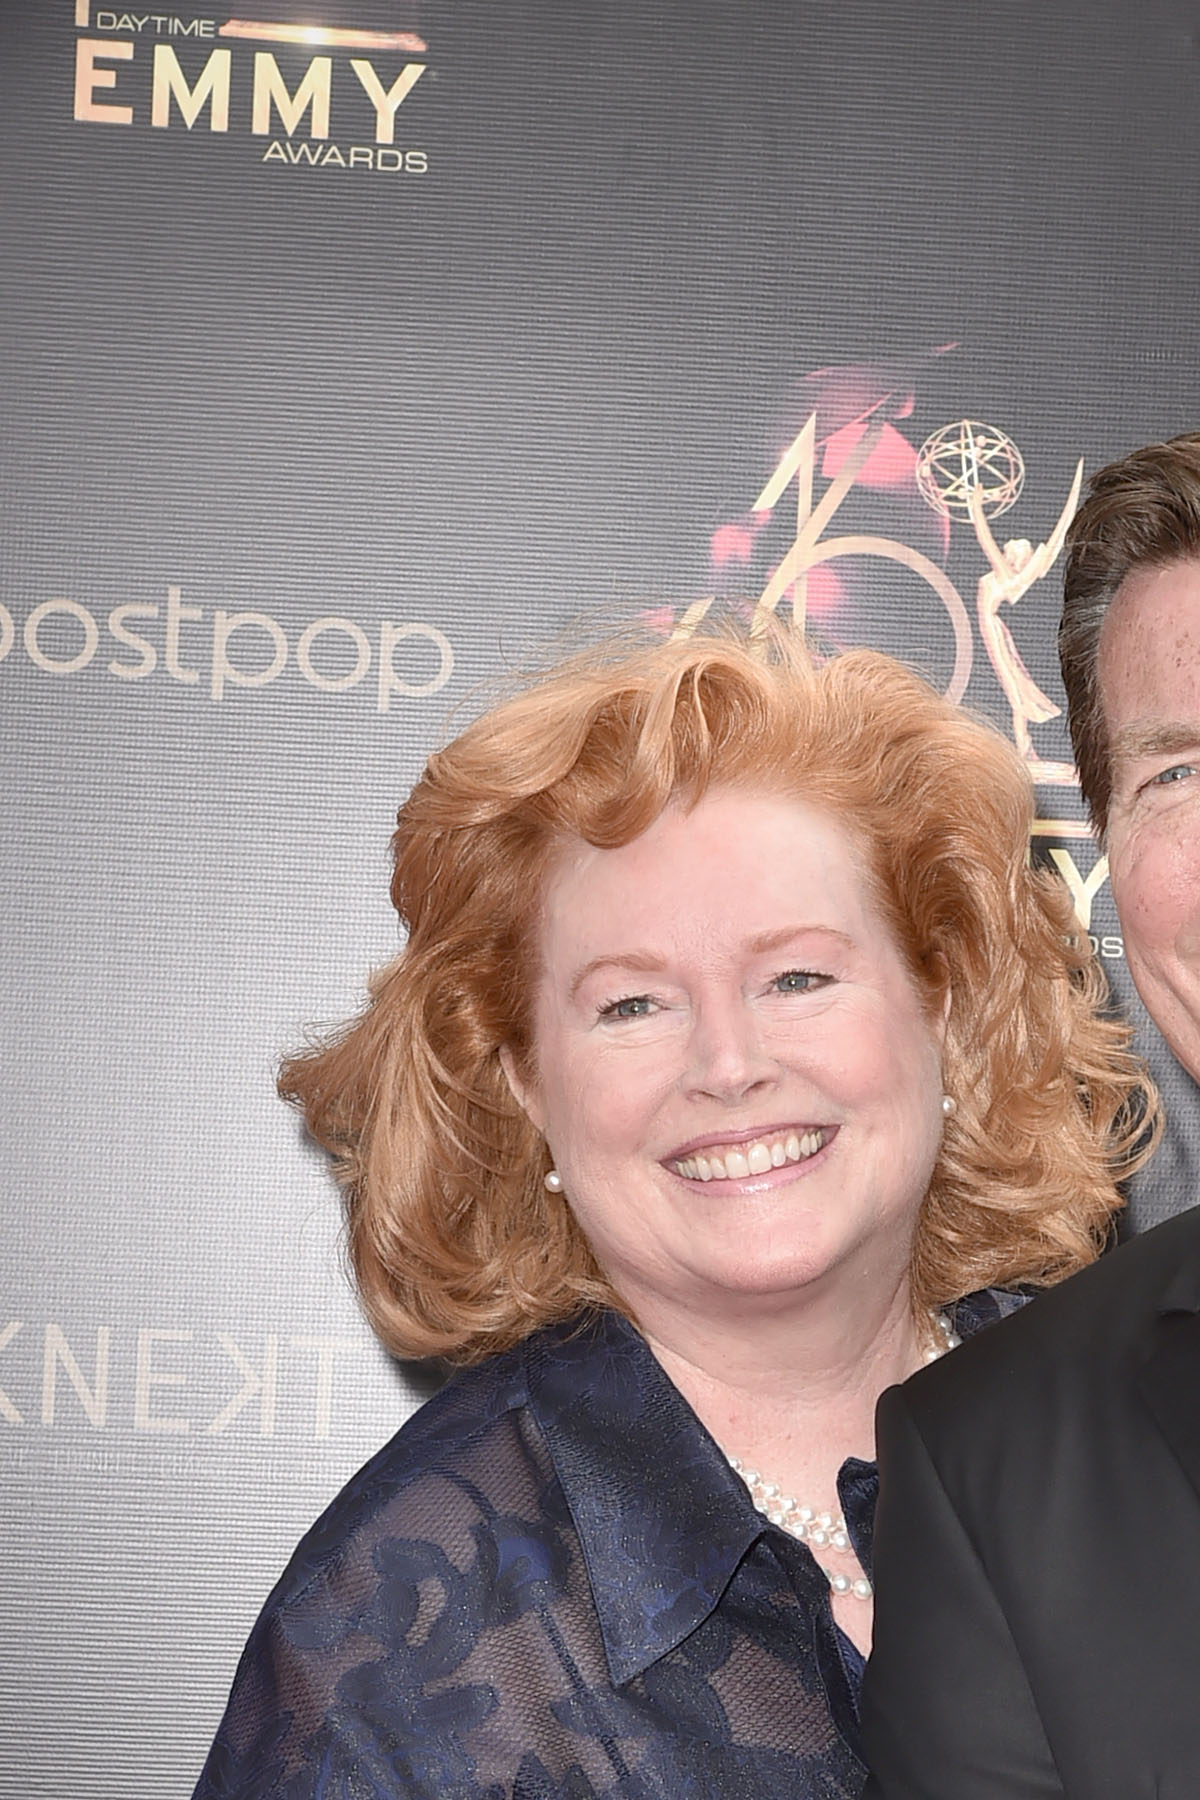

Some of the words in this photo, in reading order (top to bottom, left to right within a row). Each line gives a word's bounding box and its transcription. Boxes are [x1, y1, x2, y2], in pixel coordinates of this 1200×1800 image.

[96, 12, 216, 38] DAYTIME
[74, 38, 427, 144] EMMY
[262, 141, 428, 173] AWARDS
[0, 585, 455, 712] ostpop
